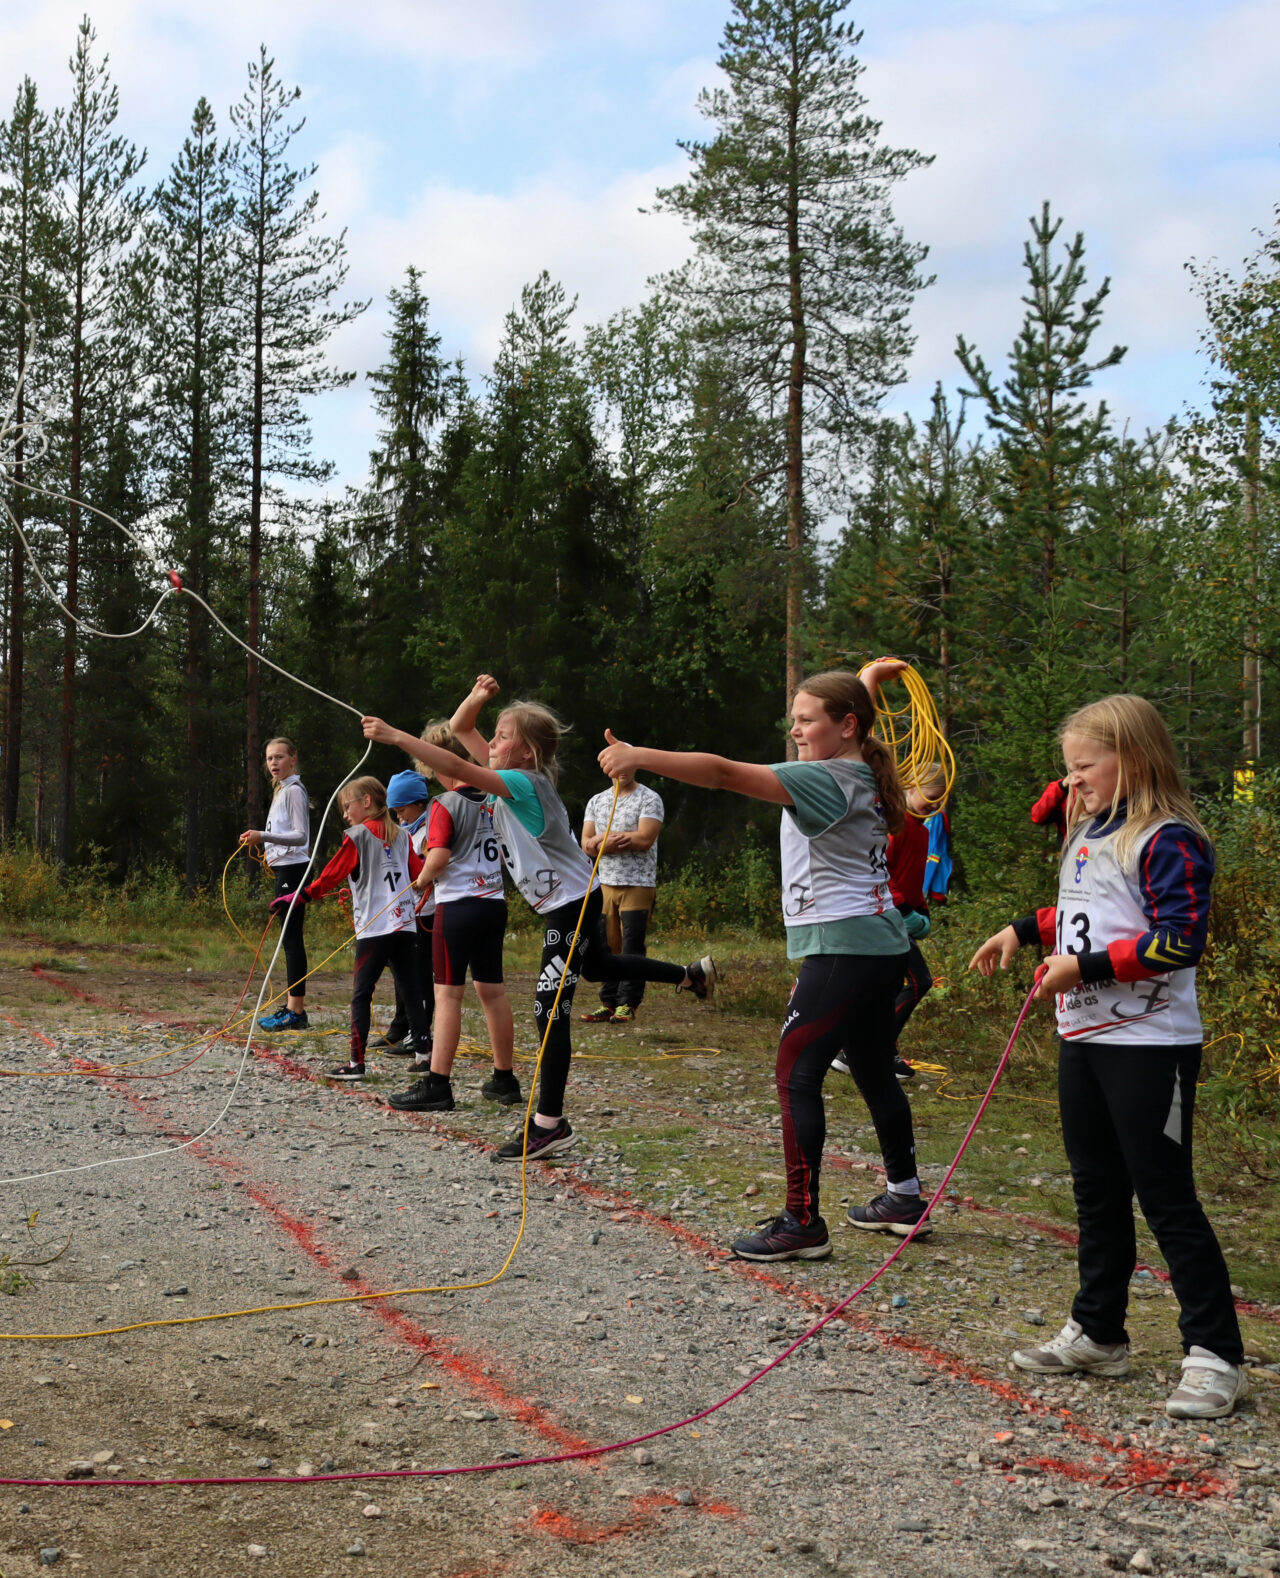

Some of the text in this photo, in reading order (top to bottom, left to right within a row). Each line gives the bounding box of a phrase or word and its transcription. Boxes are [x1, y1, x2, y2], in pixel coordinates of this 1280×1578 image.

[474, 838, 499, 862] 16
[383, 871, 402, 893] 17
[1057, 910, 1092, 955] 13
[536, 973, 578, 992] adidas
[1084, 994, 1099, 1006] as
